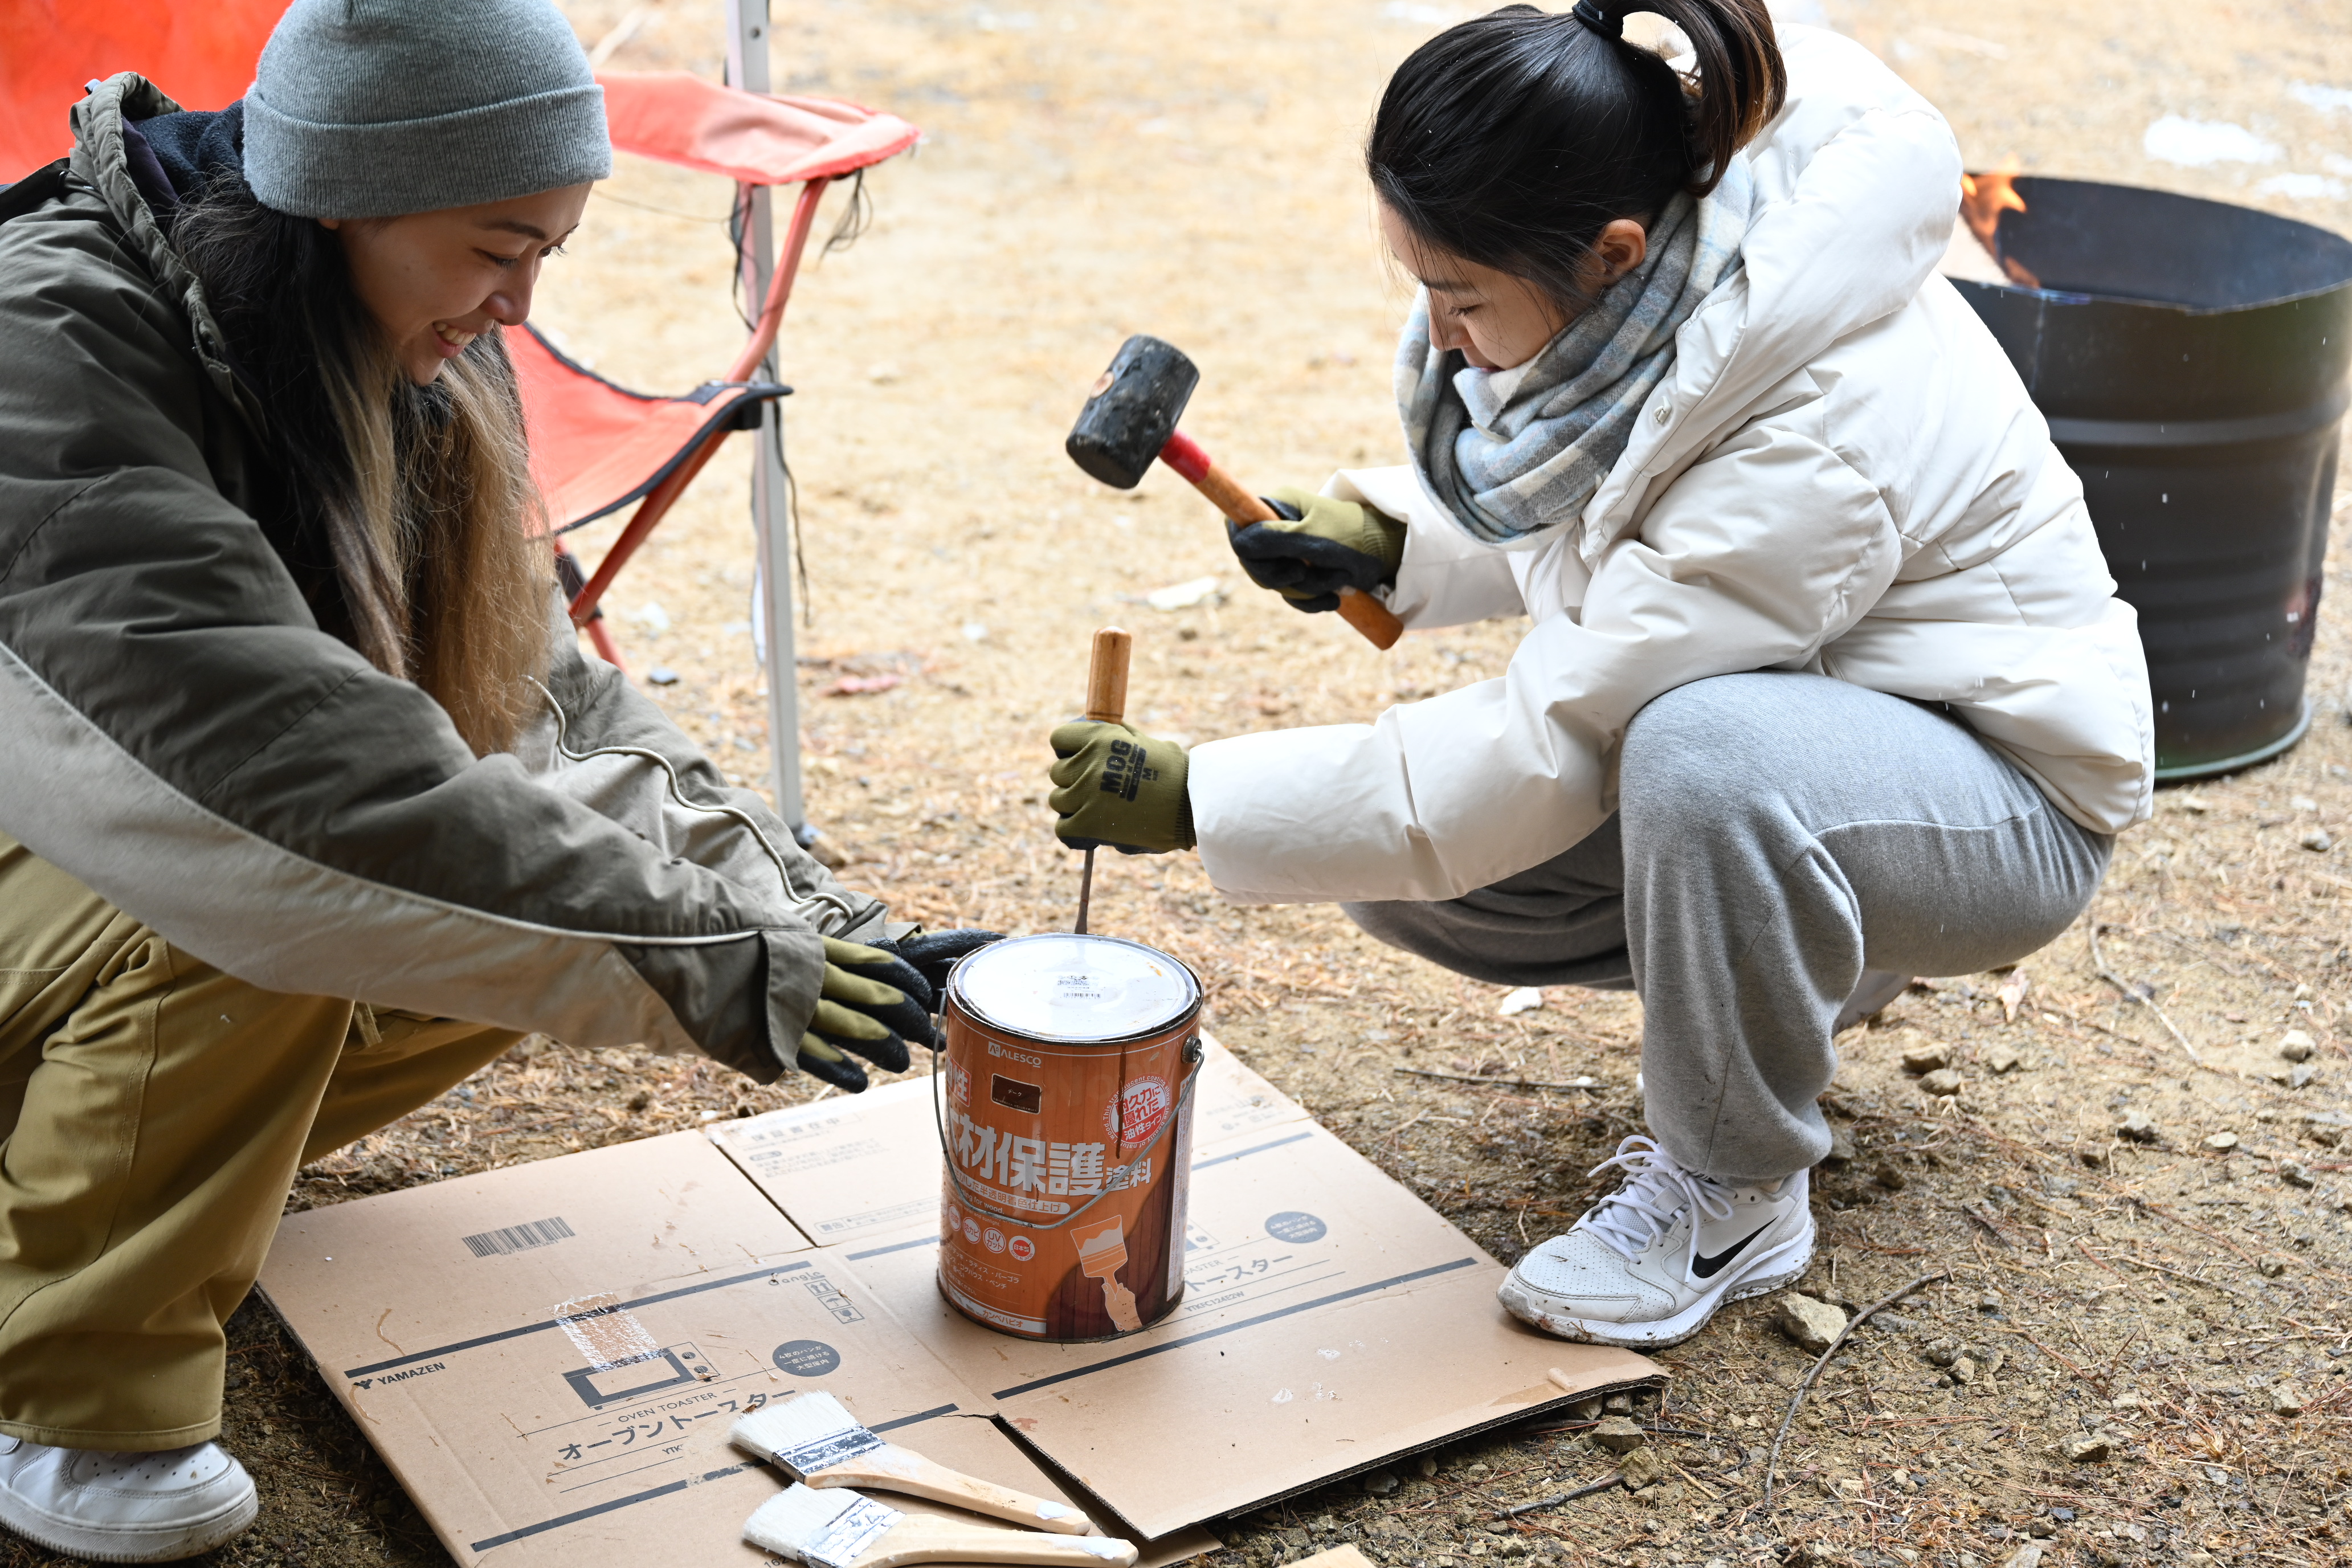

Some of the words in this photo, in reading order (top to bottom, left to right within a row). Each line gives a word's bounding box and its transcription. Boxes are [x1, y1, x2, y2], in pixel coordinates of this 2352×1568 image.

[1100, 740, 1132, 794] MOG
[1142, 767, 1153, 781] M
[1001, 1049, 1042, 1068] ALESCO
[1146, 1075, 1166, 1086] coating
[1124, 1113, 1162, 1141] 油性タイプ
[1114, 1140, 1137, 1149] naturl
[974, 1197, 983, 1206] for
[984, 1202, 1004, 1215] wood.
[986, 1238, 1003, 1251] カット
[988, 1231, 1001, 1242] UV
[1010, 1250, 1019, 1259] MADE
[376, 1362, 446, 1385] YAMAZEN
[618, 1407, 656, 1423] OVEN
[657, 1392, 718, 1412] TOASTER
[558, 1390, 796, 1460] オーブントースター
